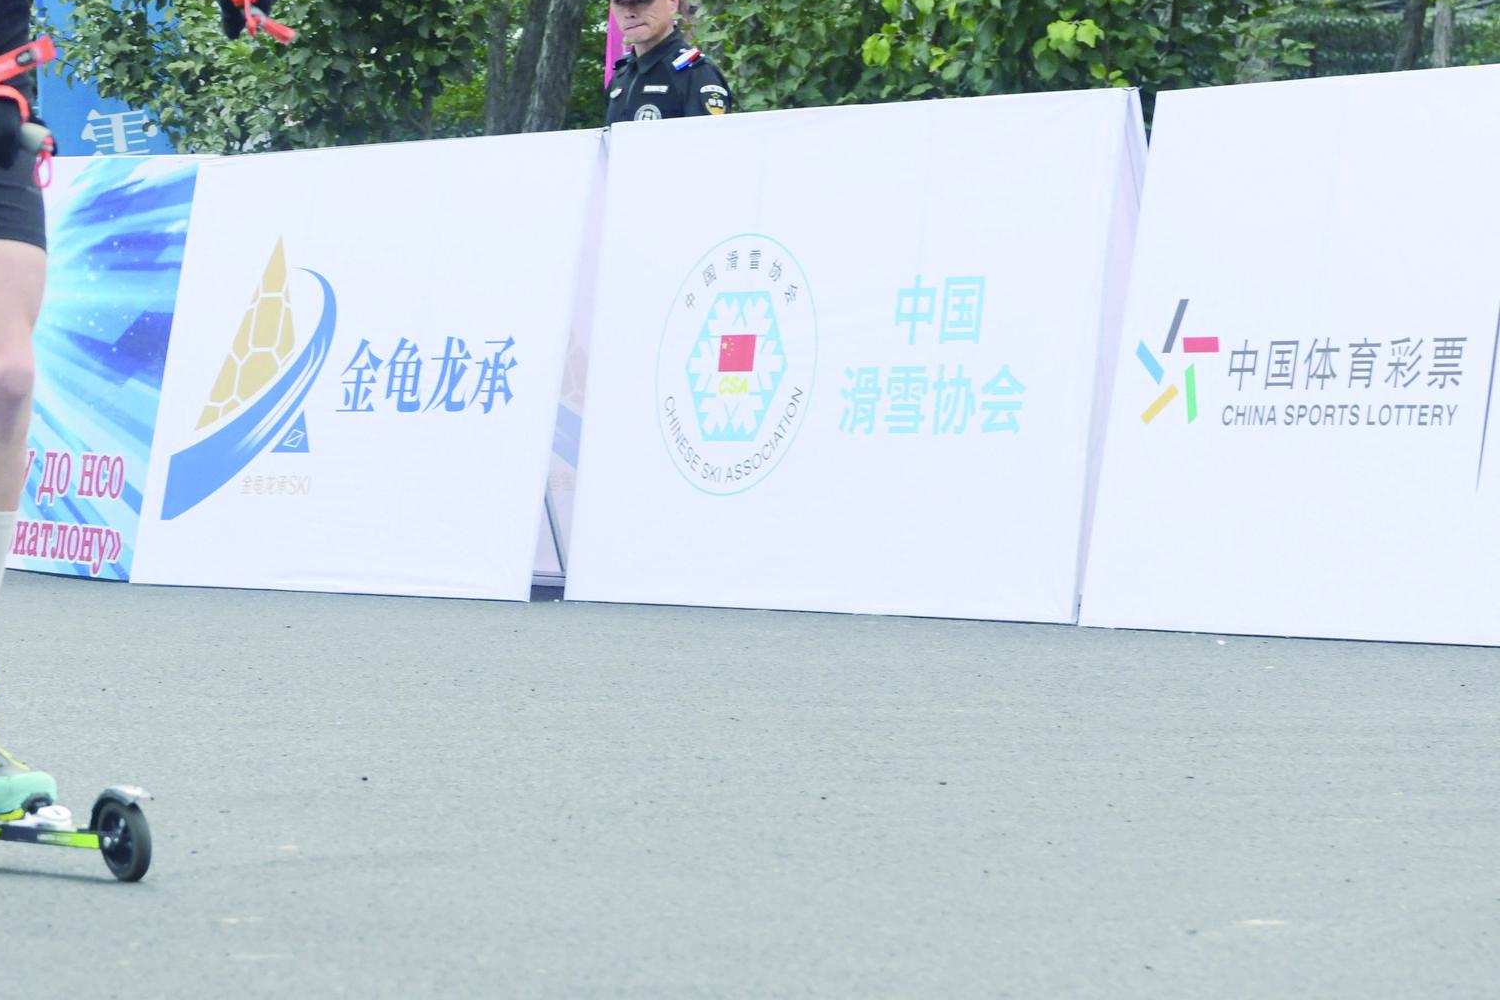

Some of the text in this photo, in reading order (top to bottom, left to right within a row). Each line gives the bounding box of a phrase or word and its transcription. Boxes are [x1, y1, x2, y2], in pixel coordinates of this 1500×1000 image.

[895, 274, 986, 346] 中国
[335, 334, 518, 415] 金龟龙承
[717, 376, 749, 395] CSA
[1227, 336, 1468, 391] 中国体育彩票
[839, 364, 1027, 436] 滑雪协会
[1221, 404, 1459, 427] CHINA SPORTS LOTTERY
[664, 386, 804, 483] CHINESE SKI ASSOCIATION
[12, 520, 122, 575] иатлону»
